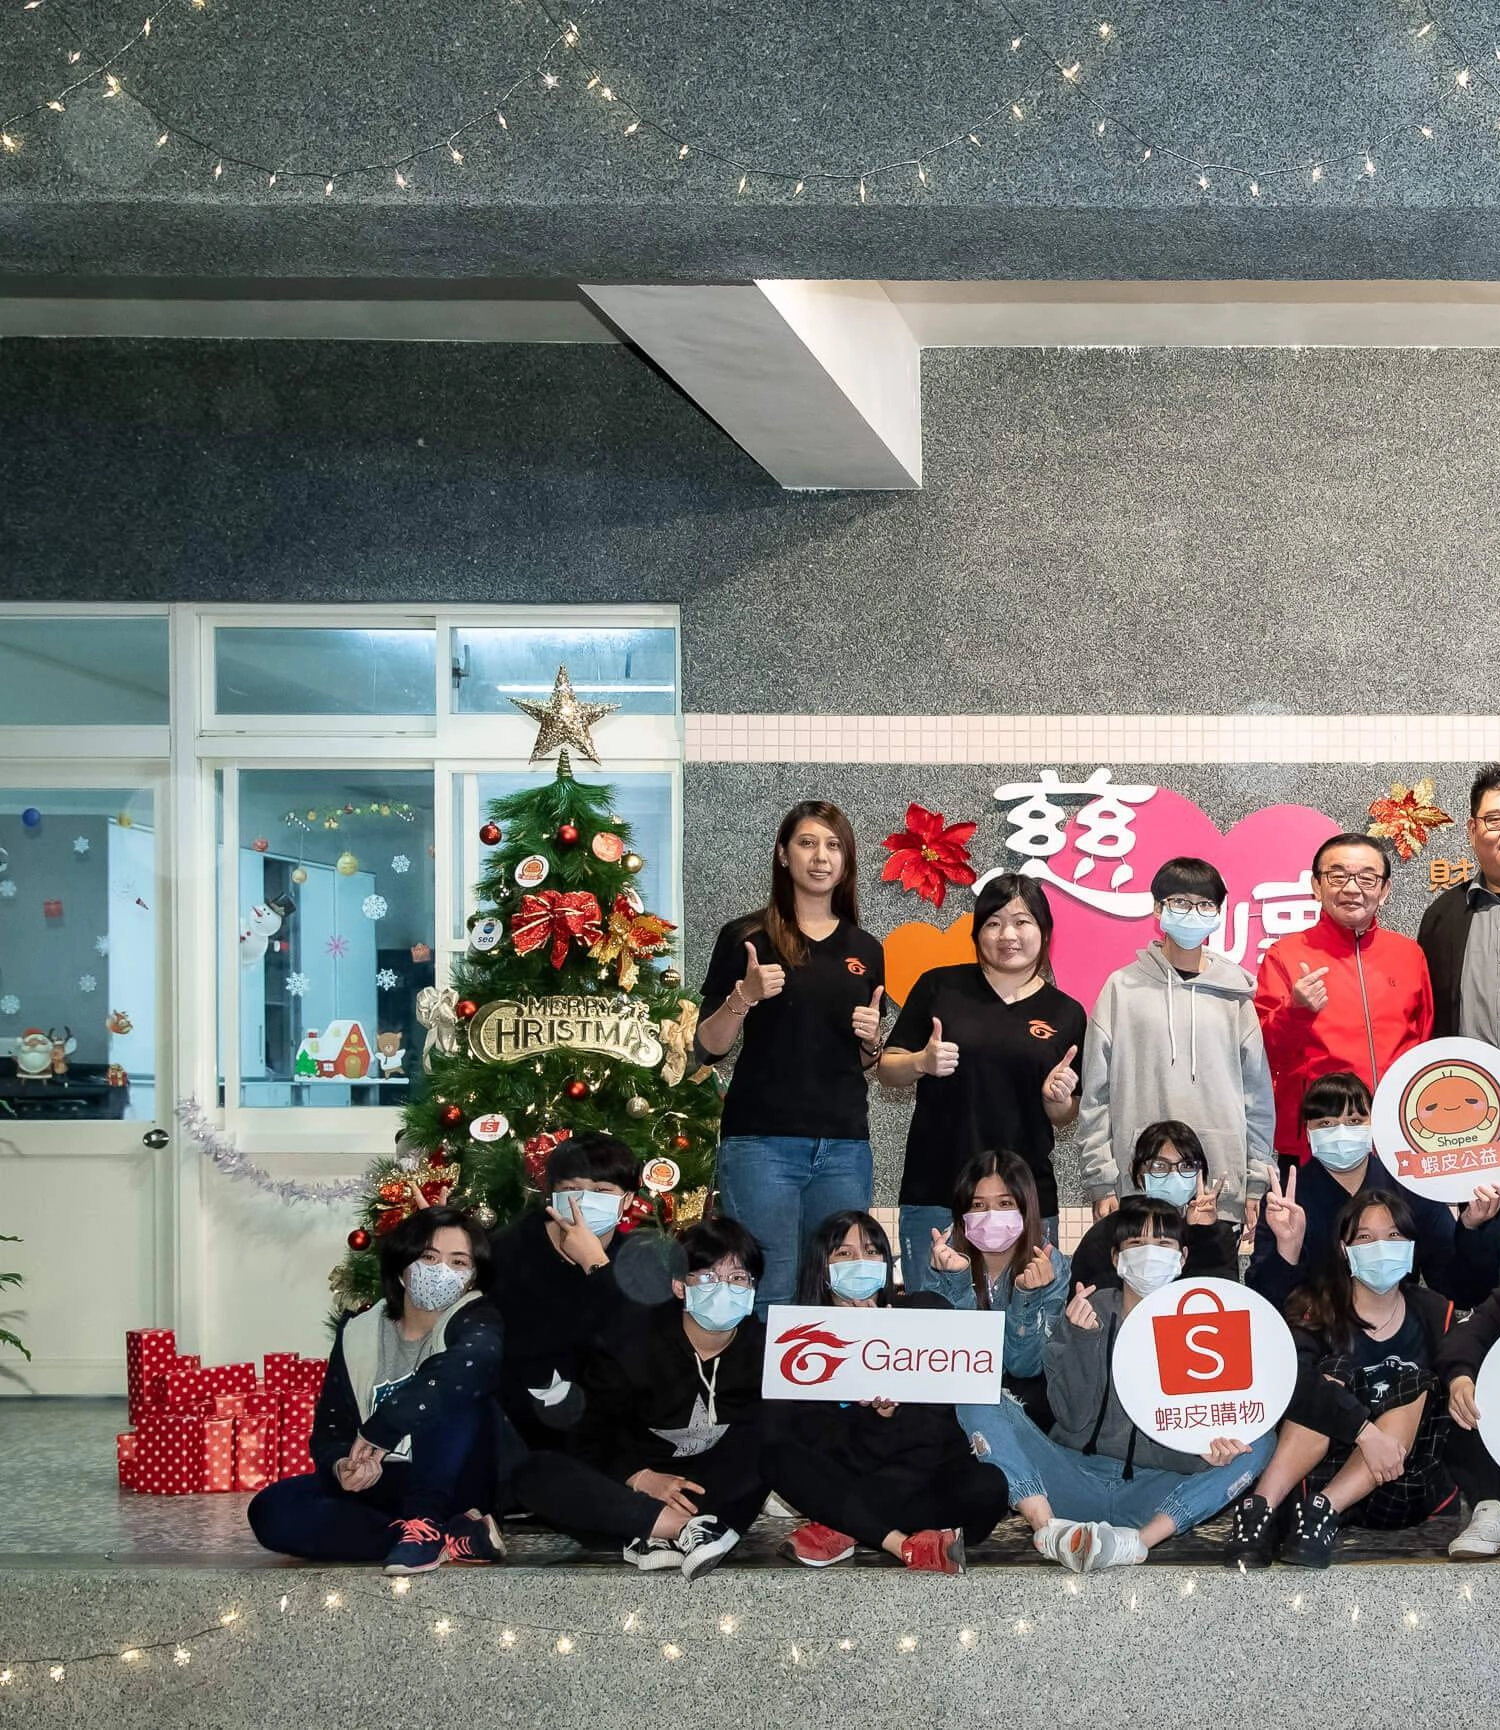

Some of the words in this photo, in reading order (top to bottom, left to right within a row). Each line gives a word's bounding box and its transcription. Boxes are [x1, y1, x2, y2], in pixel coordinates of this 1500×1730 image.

[477, 935, 495, 943] sea
[525, 996, 617, 1017] MERRY
[468, 999, 663, 1067] CHRISTMAS
[1437, 1135, 1479, 1147] Shopee
[1420, 1147, 1498, 1174] 蝦皮公益
[861, 1338, 994, 1374] Garena
[1185, 1324, 1225, 1380] S
[1155, 1399, 1265, 1432] 蝦皮購物
